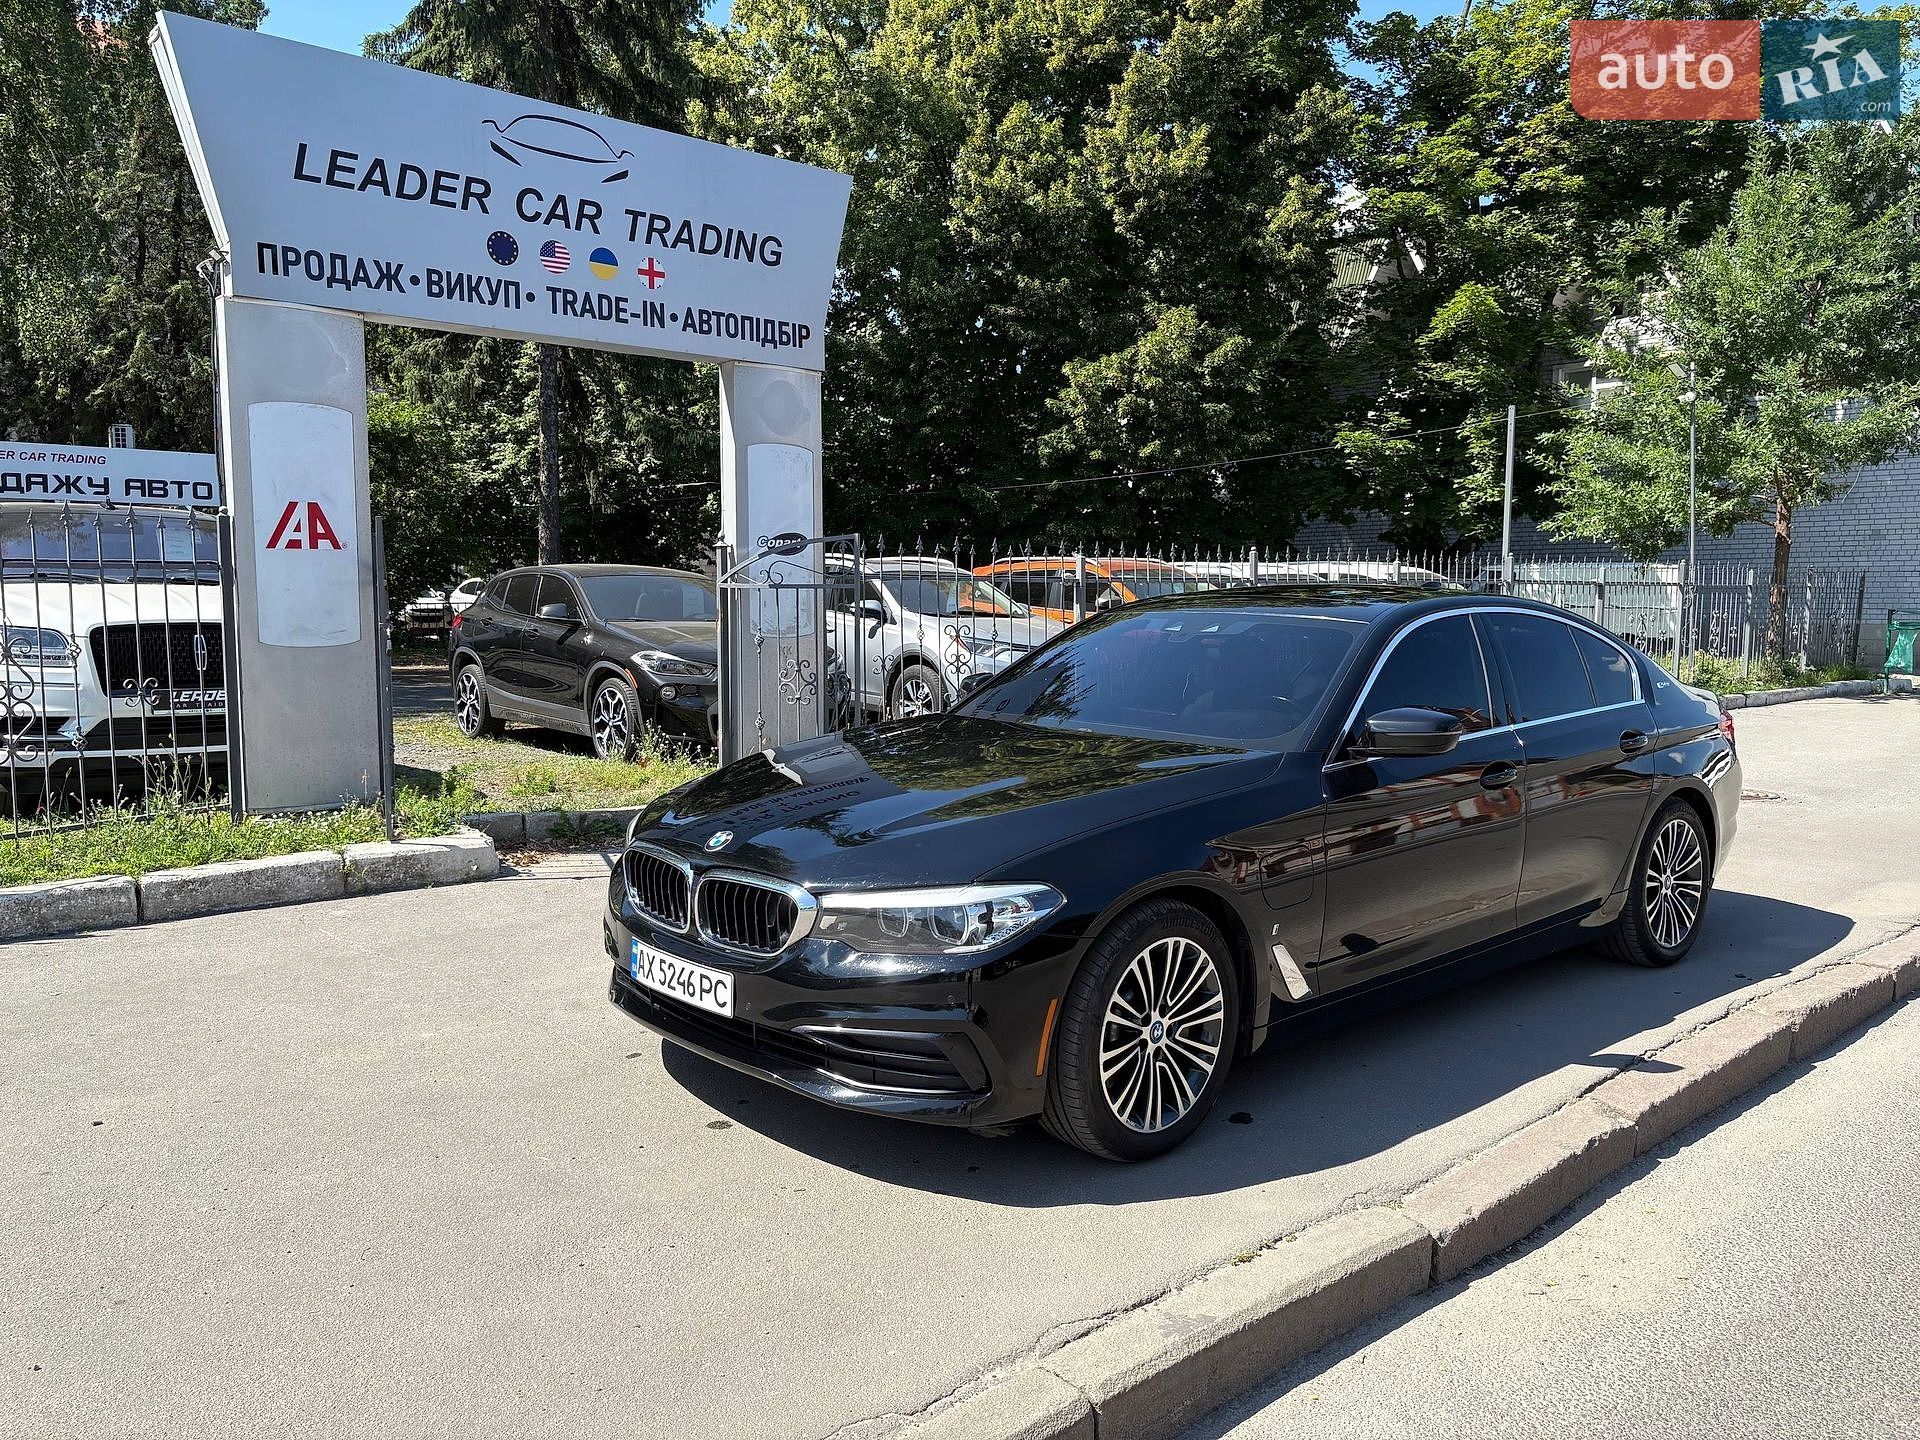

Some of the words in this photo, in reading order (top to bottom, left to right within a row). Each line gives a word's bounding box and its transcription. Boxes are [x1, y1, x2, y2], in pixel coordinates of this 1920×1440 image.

[293, 142, 492, 215] LEADER
[516, 187, 603, 235] CAR
[624, 208, 783, 267] TRADING
[256, 241, 406, 294] ПРОДАЖ
[426, 268, 521, 310] ВИКУП
[546, 285, 665, 329] TRADE-IN
[681, 306, 811, 349] АВТОПІДБІР
[19, 451, 47, 462] CAR
[50, 453, 107, 465] TRADING
[124, 478, 213, 500] АВТО
[638, 949, 656, 983] AX
[659, 958, 696, 998] 5246
[700, 973, 728, 1009] PC
